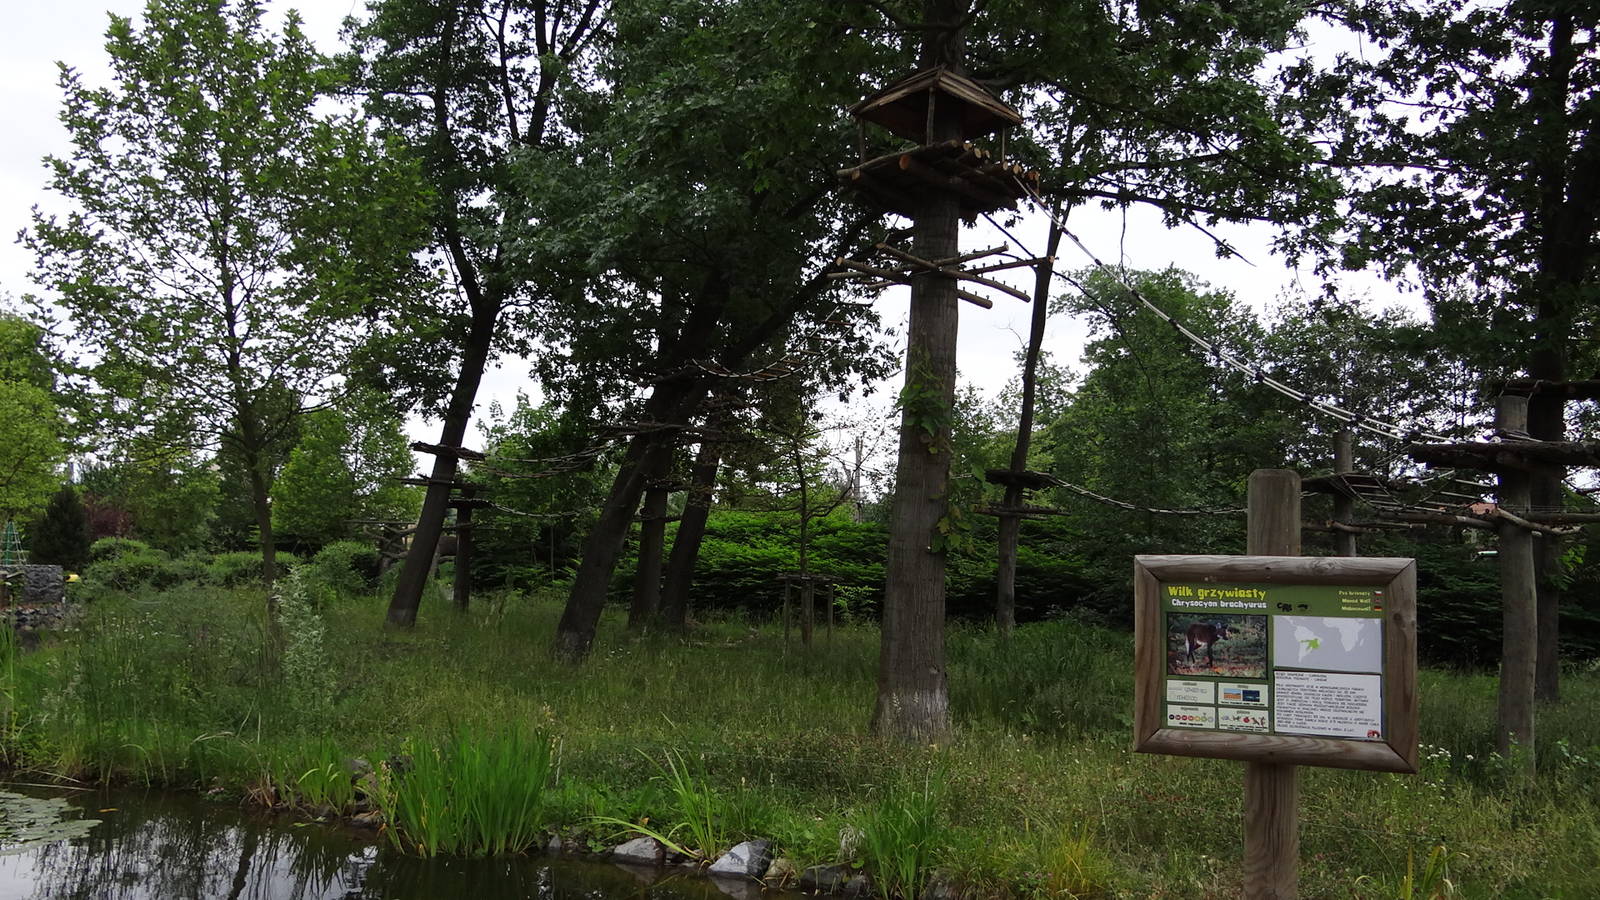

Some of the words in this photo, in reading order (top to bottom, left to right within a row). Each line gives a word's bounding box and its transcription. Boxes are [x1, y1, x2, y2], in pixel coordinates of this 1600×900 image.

[1168, 586, 1193, 597] Wilk
[1197, 587, 1266, 601] grzywiasty
[1171, 598, 1218, 608] Chrysocyon
[1220, 600, 1267, 610] brachyurus
